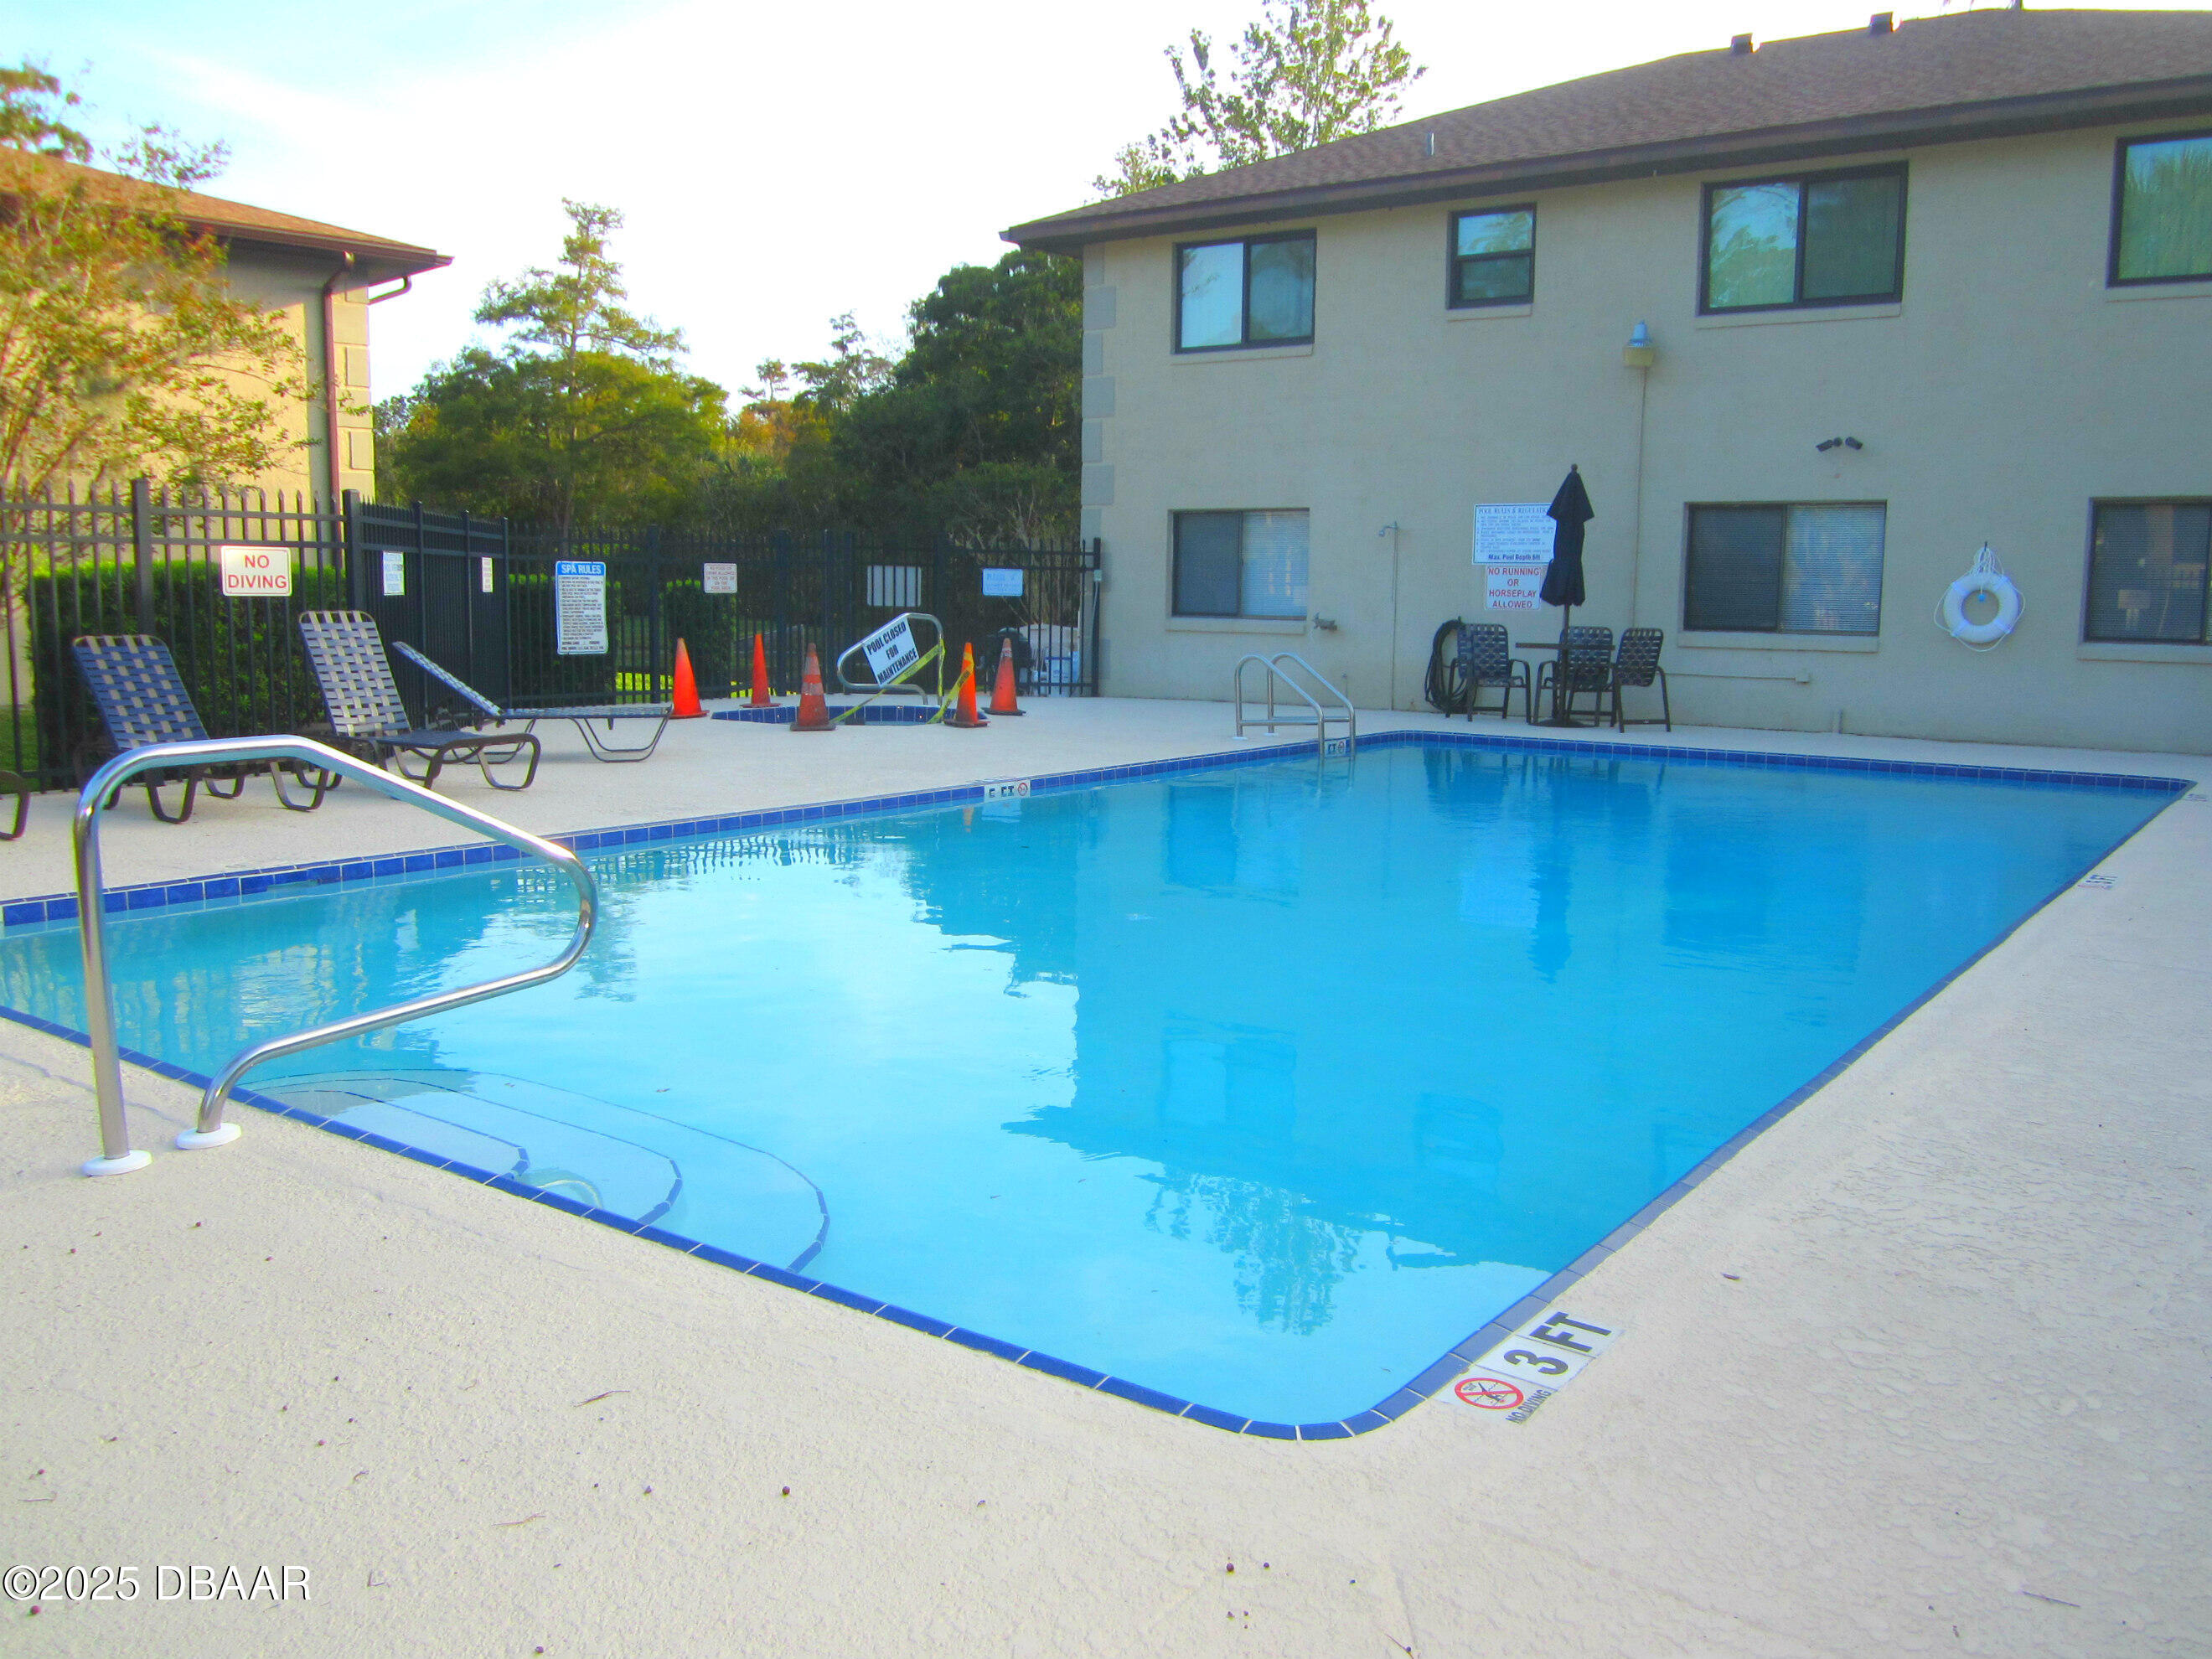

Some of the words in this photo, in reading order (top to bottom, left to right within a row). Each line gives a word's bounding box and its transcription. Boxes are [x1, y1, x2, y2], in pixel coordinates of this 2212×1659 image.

[245, 555, 270, 568] NO
[561, 564, 577, 574] SPA
[577, 565, 602, 574] RULES
[1488, 567, 1500, 576] NO
[1502, 567, 1540, 576] RUNNING
[228, 575, 287, 588] DIVING
[1507, 578, 1519, 587] OR
[1489, 589, 1537, 597] HORSEPLAY
[1492, 600, 1532, 608] ALLOWED
[866, 638, 886, 655] POOL
[882, 621, 907, 644] CLOSED
[886, 644, 899, 659] FOR
[877, 648, 917, 685] MAINTENANCE
[1529, 1311, 1612, 1352] FT
[1504, 1349, 1569, 1375] 3
[1505, 1411, 1526, 1424] NO
[1518, 1389, 1552, 1414] DIVING
